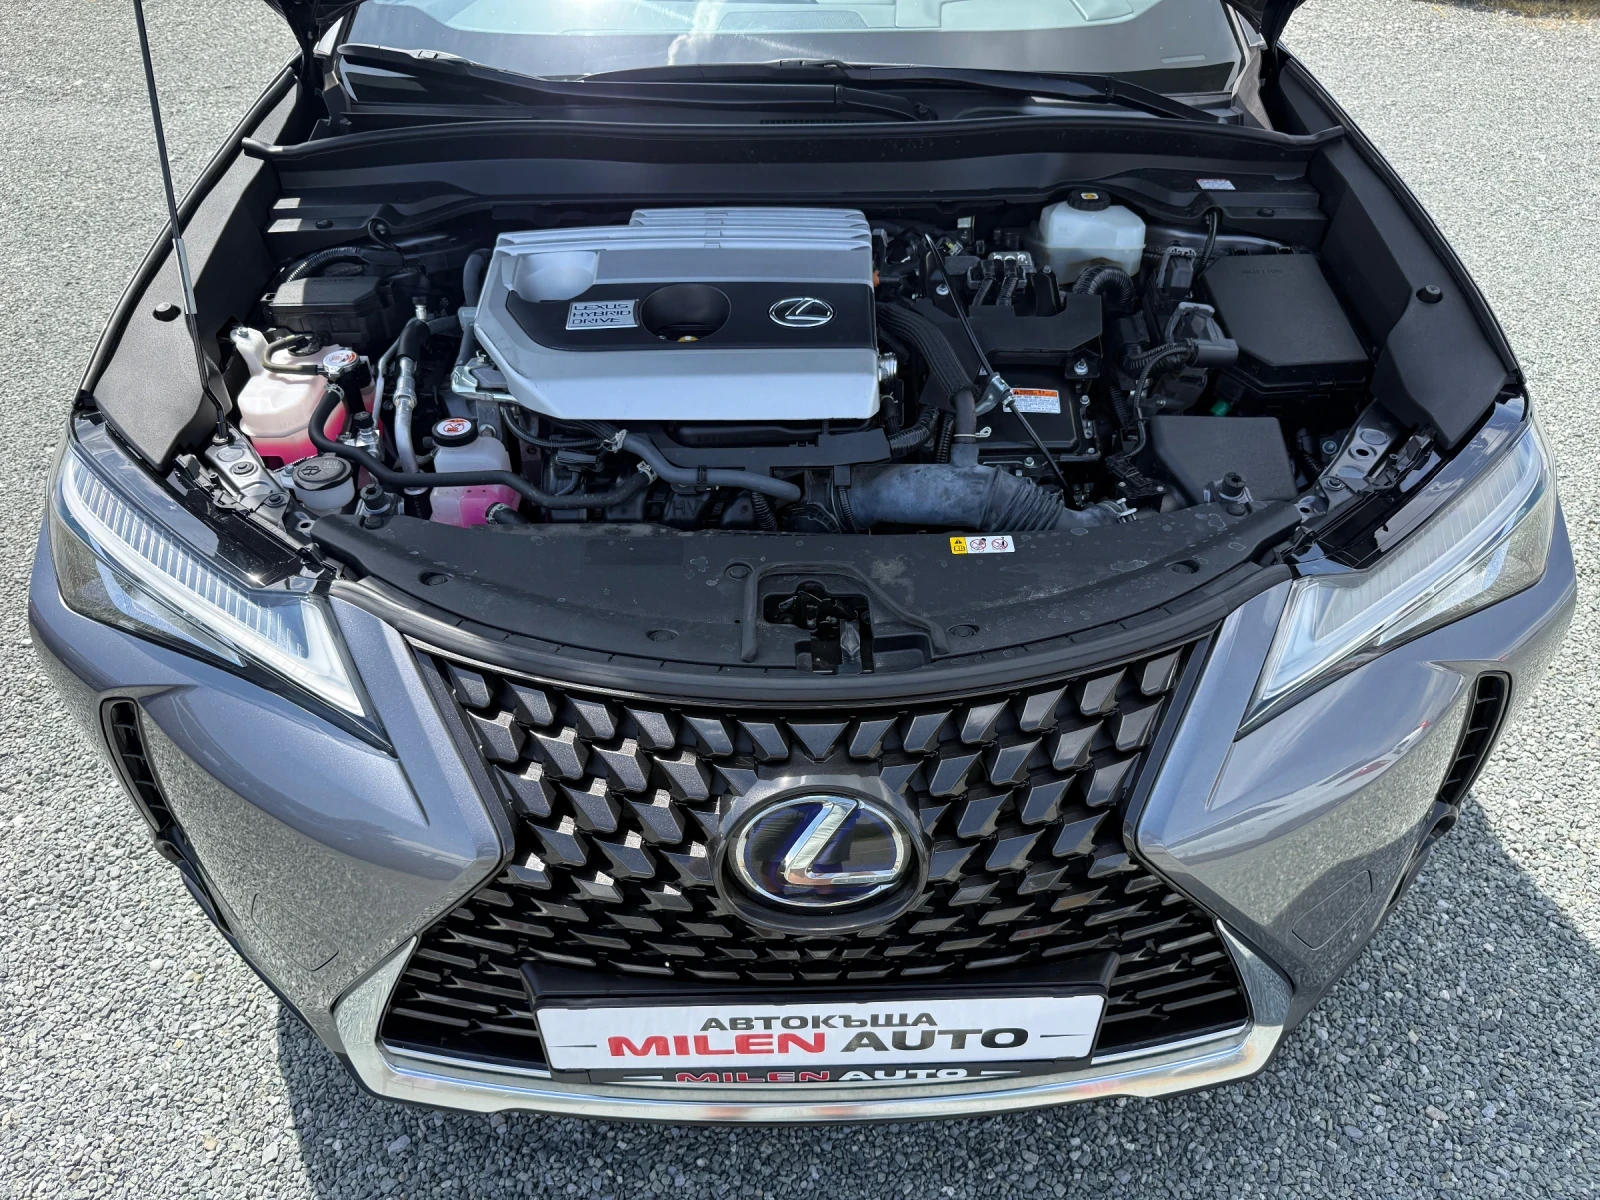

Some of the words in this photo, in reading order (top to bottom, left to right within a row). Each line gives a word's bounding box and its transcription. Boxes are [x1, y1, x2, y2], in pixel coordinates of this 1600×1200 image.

[700, 1012, 938, 1032] АВТОКЪША
[607, 1032, 826, 1057] MILEN
[840, 1028, 1029, 1053] AUTO
[675, 1071, 829, 1083] MILEN
[838, 1068, 968, 1081] AUTO
